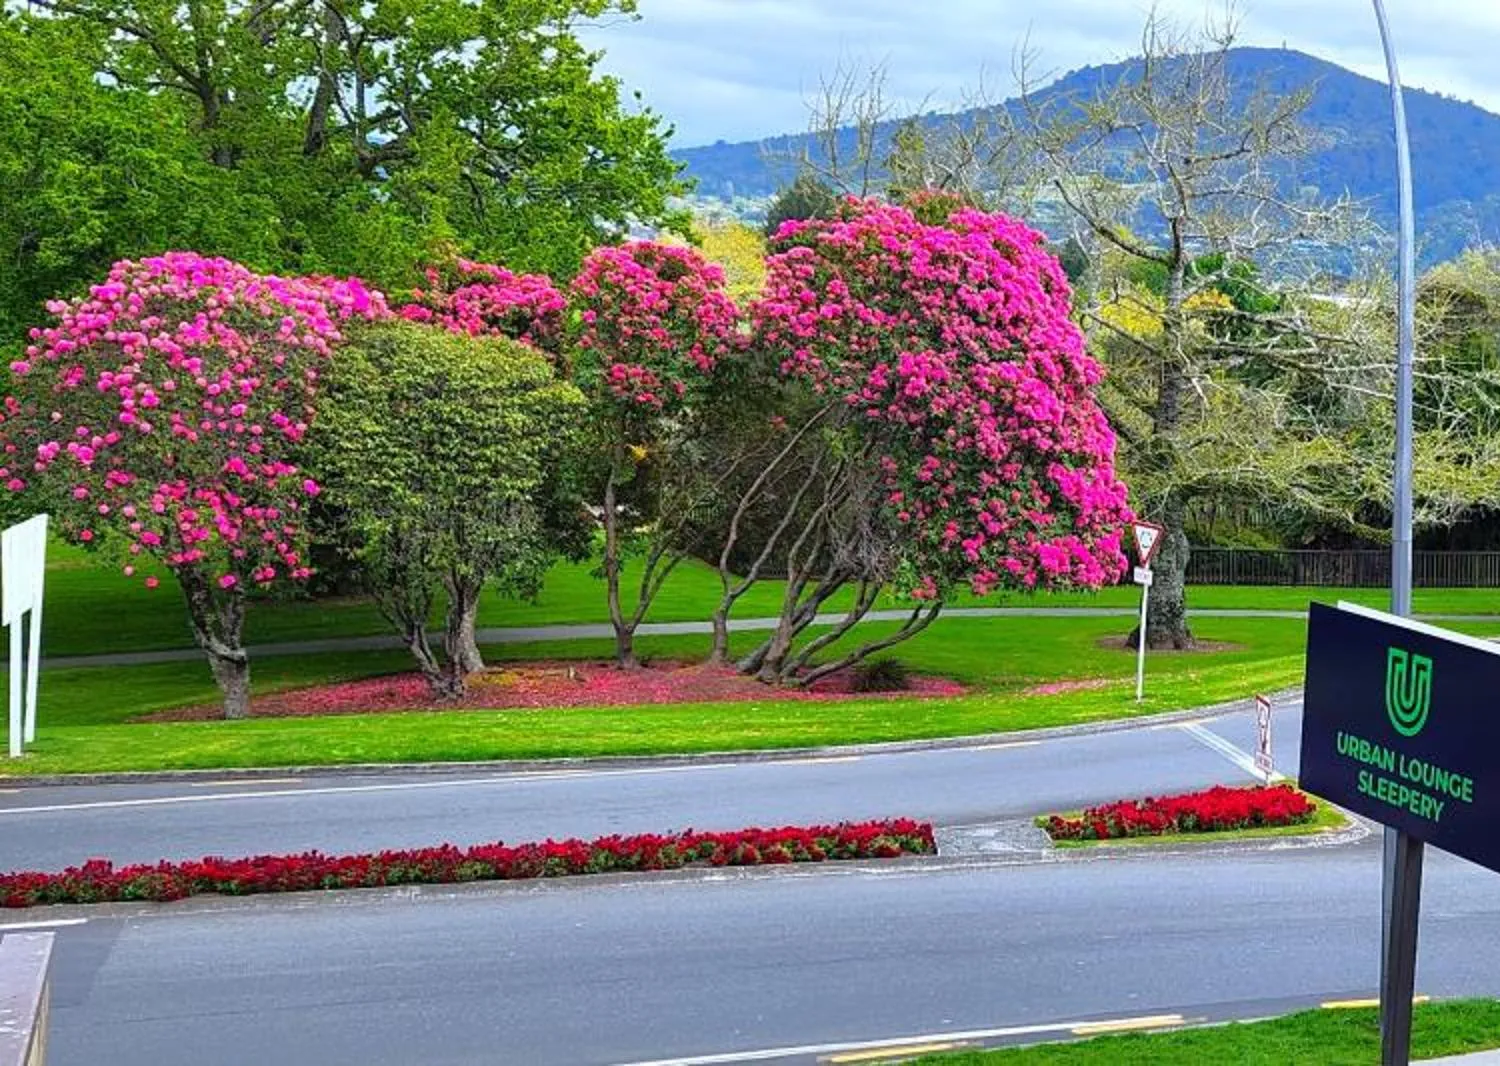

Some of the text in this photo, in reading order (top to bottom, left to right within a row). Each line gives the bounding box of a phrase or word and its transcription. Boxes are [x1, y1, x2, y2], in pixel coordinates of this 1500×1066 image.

[1336, 731, 1473, 803] URBAN LOUNGE
[1357, 769, 1445, 822] SLEEPERY
